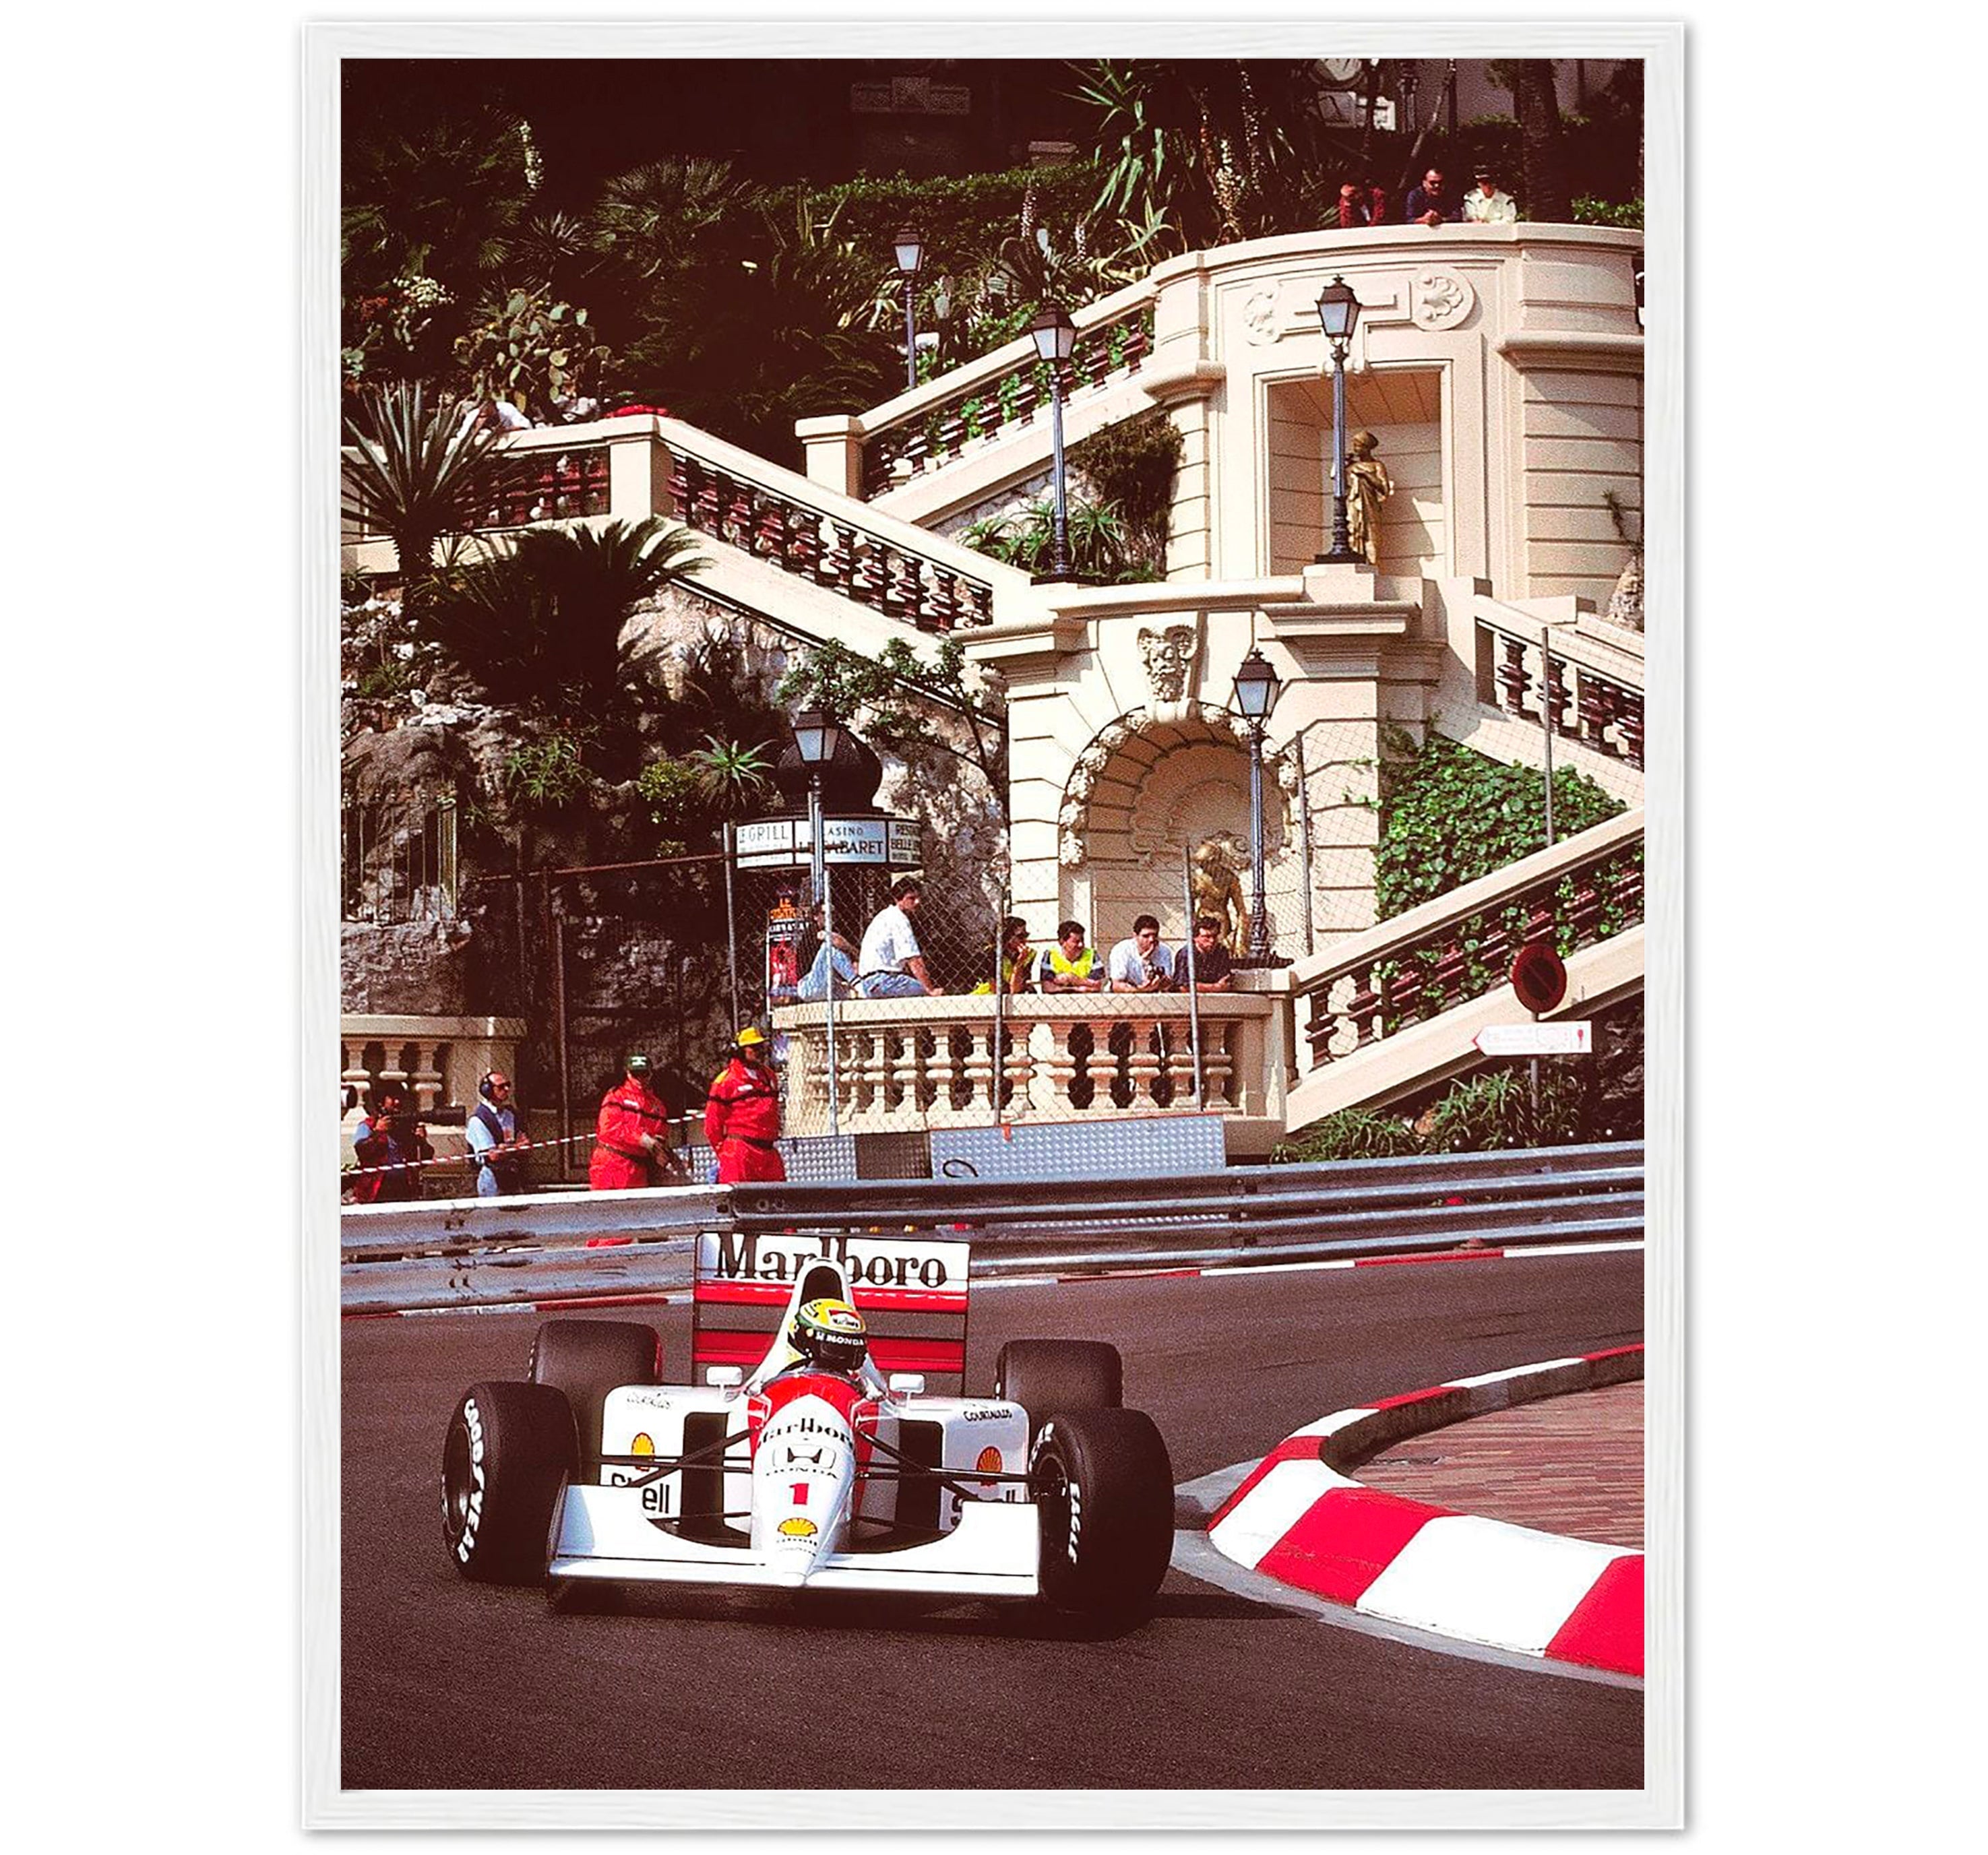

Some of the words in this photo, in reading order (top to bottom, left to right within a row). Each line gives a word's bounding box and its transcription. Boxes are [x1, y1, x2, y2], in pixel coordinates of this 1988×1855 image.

[749, 825, 789, 842] GRILL
[828, 826, 864, 836] ASINO
[714, 1232, 948, 1288] Marlboro
[788, 1482, 809, 1505] 1
